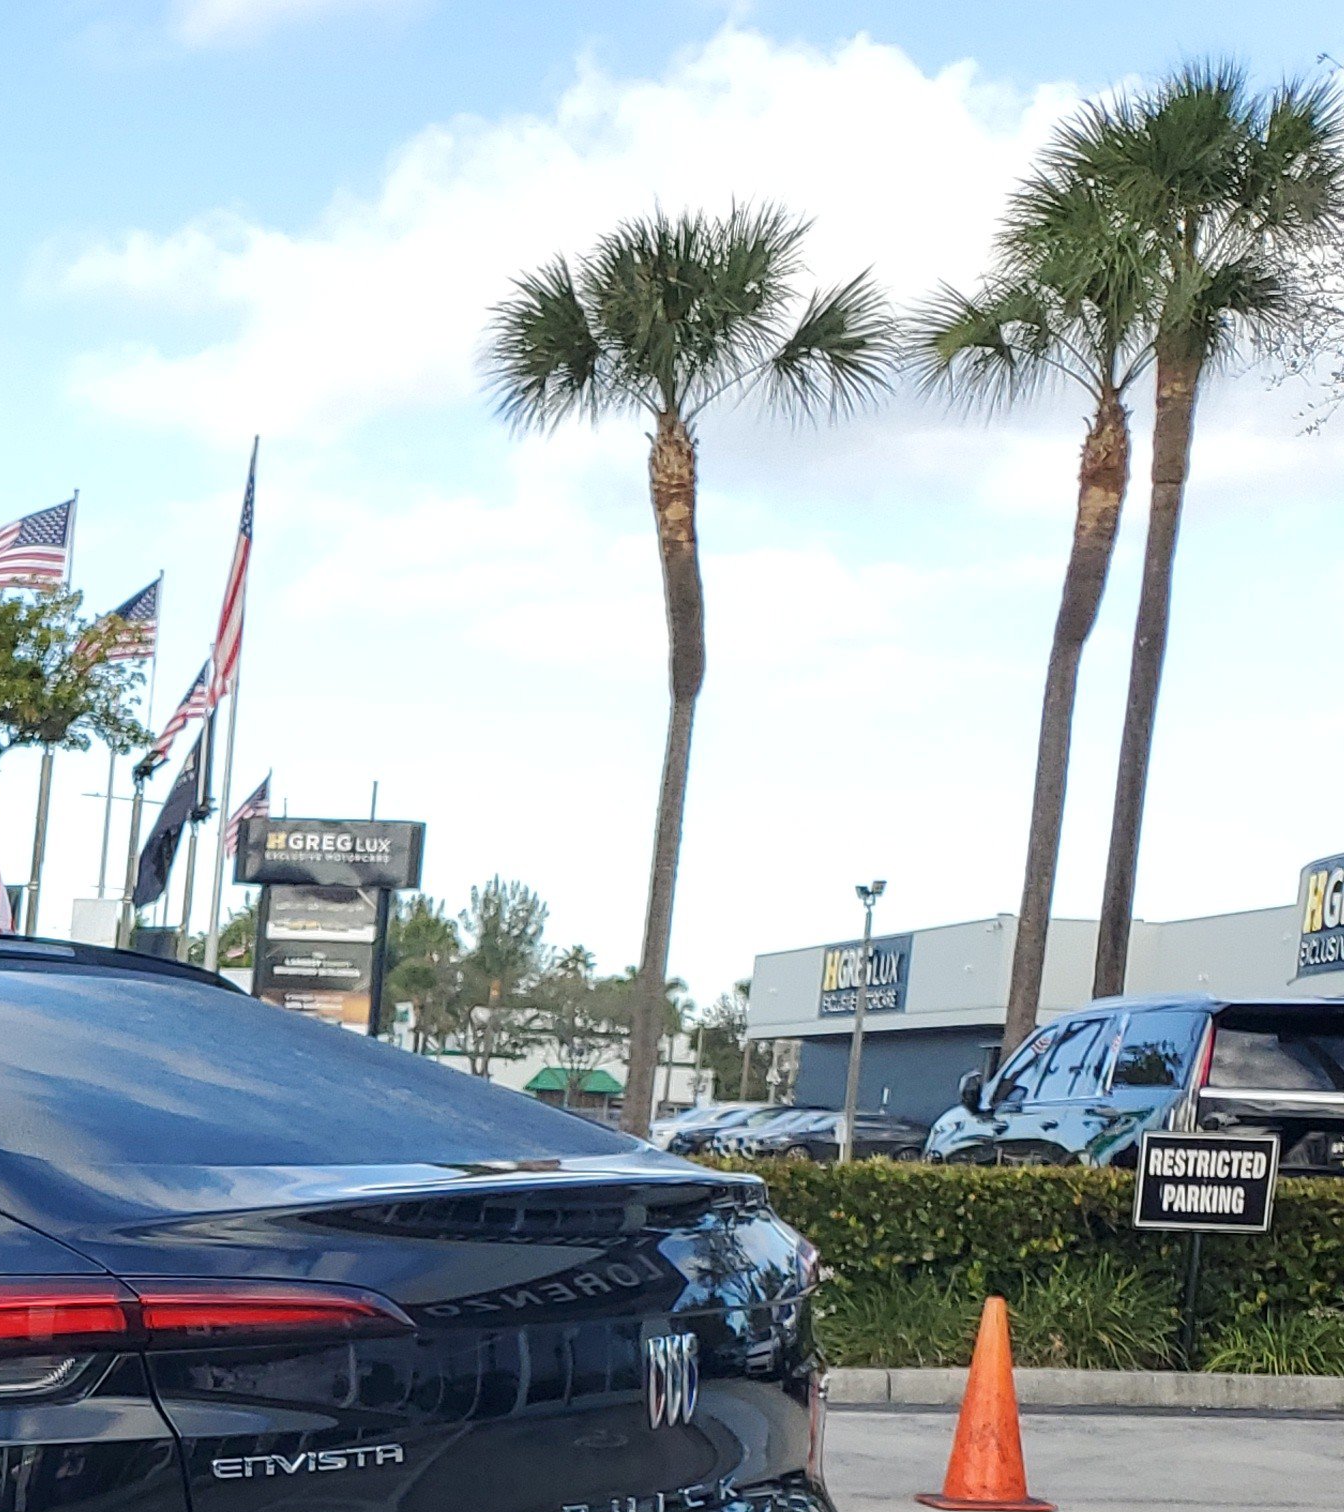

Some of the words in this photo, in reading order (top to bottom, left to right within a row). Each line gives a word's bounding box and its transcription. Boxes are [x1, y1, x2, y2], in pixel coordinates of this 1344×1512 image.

[1148, 1148, 1267, 1180] RESTRICTED
[1162, 1183, 1246, 1214] PARKING
[212, 1443, 404, 1479] ENVISTA
